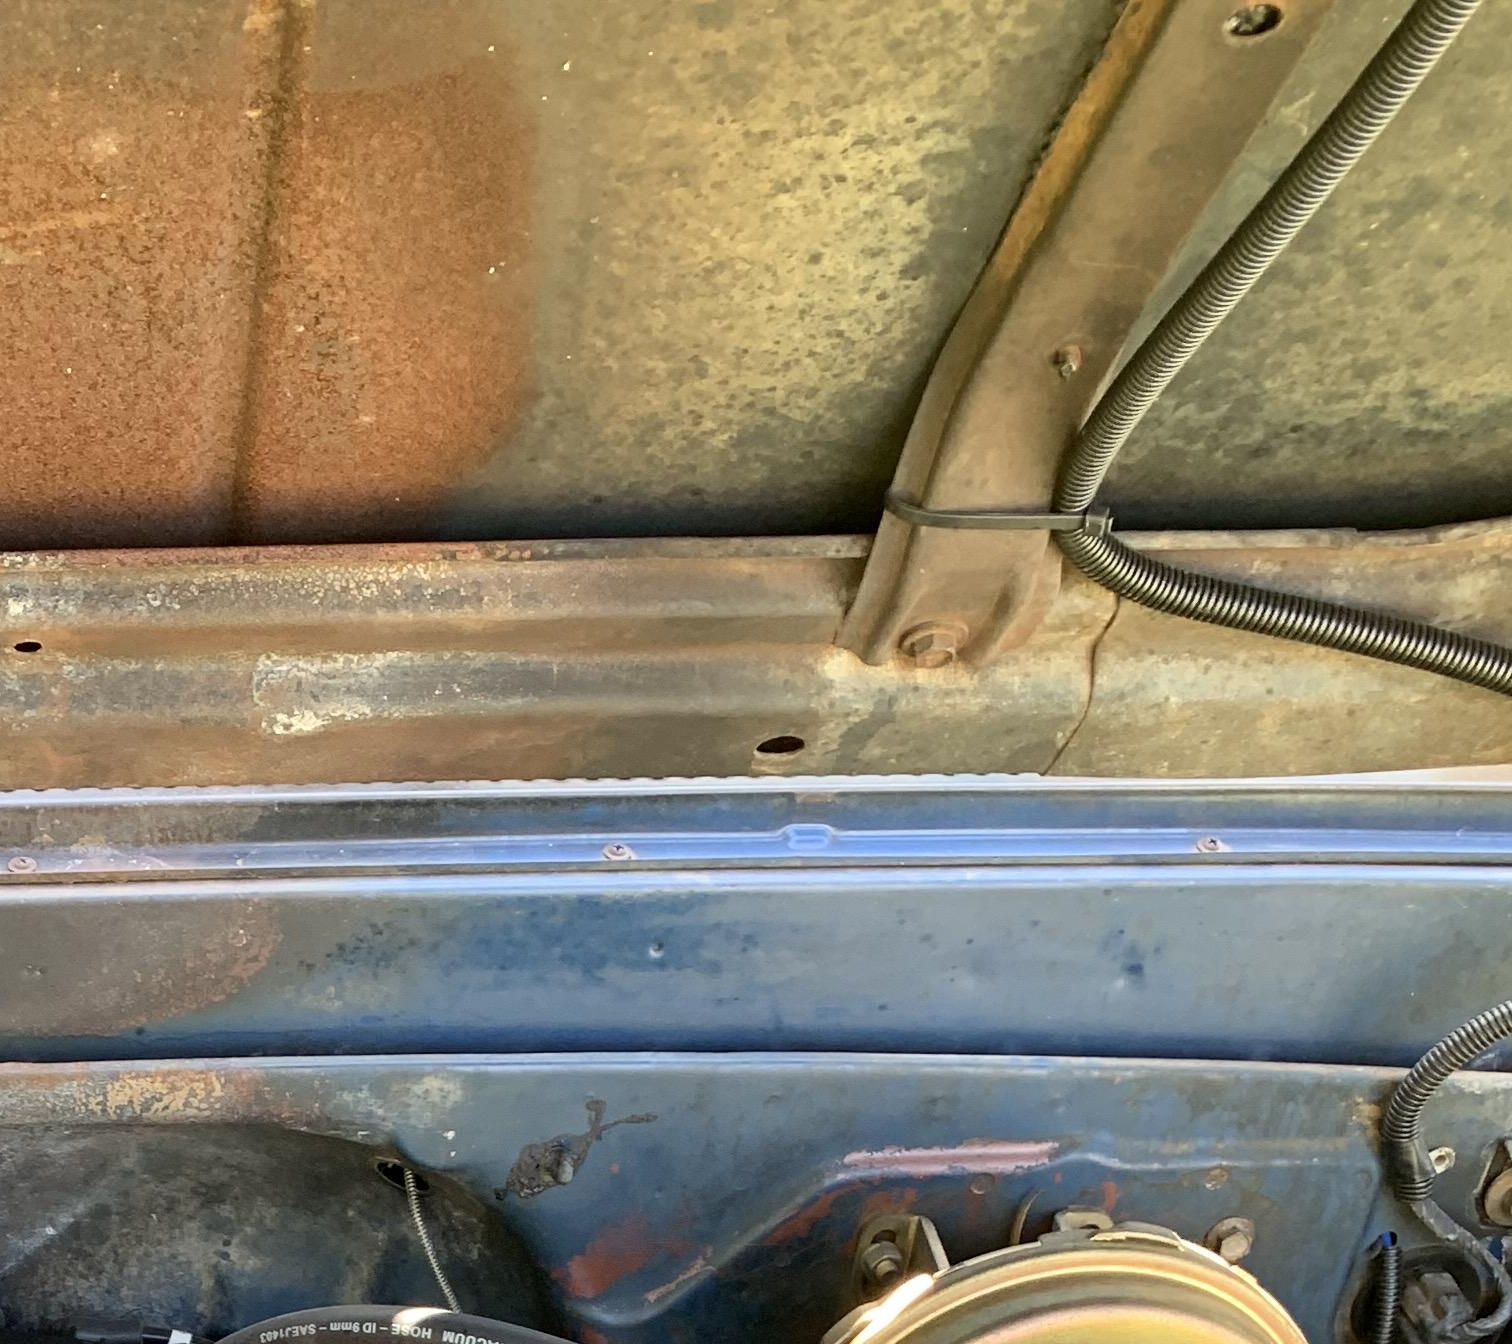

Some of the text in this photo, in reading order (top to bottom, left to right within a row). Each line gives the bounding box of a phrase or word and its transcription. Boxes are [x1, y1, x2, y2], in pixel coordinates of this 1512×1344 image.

[258, 1322, 317, 1344] SAEJ1403
[329, 1320, 360, 1334] 9mm
[362, 1321, 377, 1335] ID
[391, 1321, 433, 1340] HOSE
